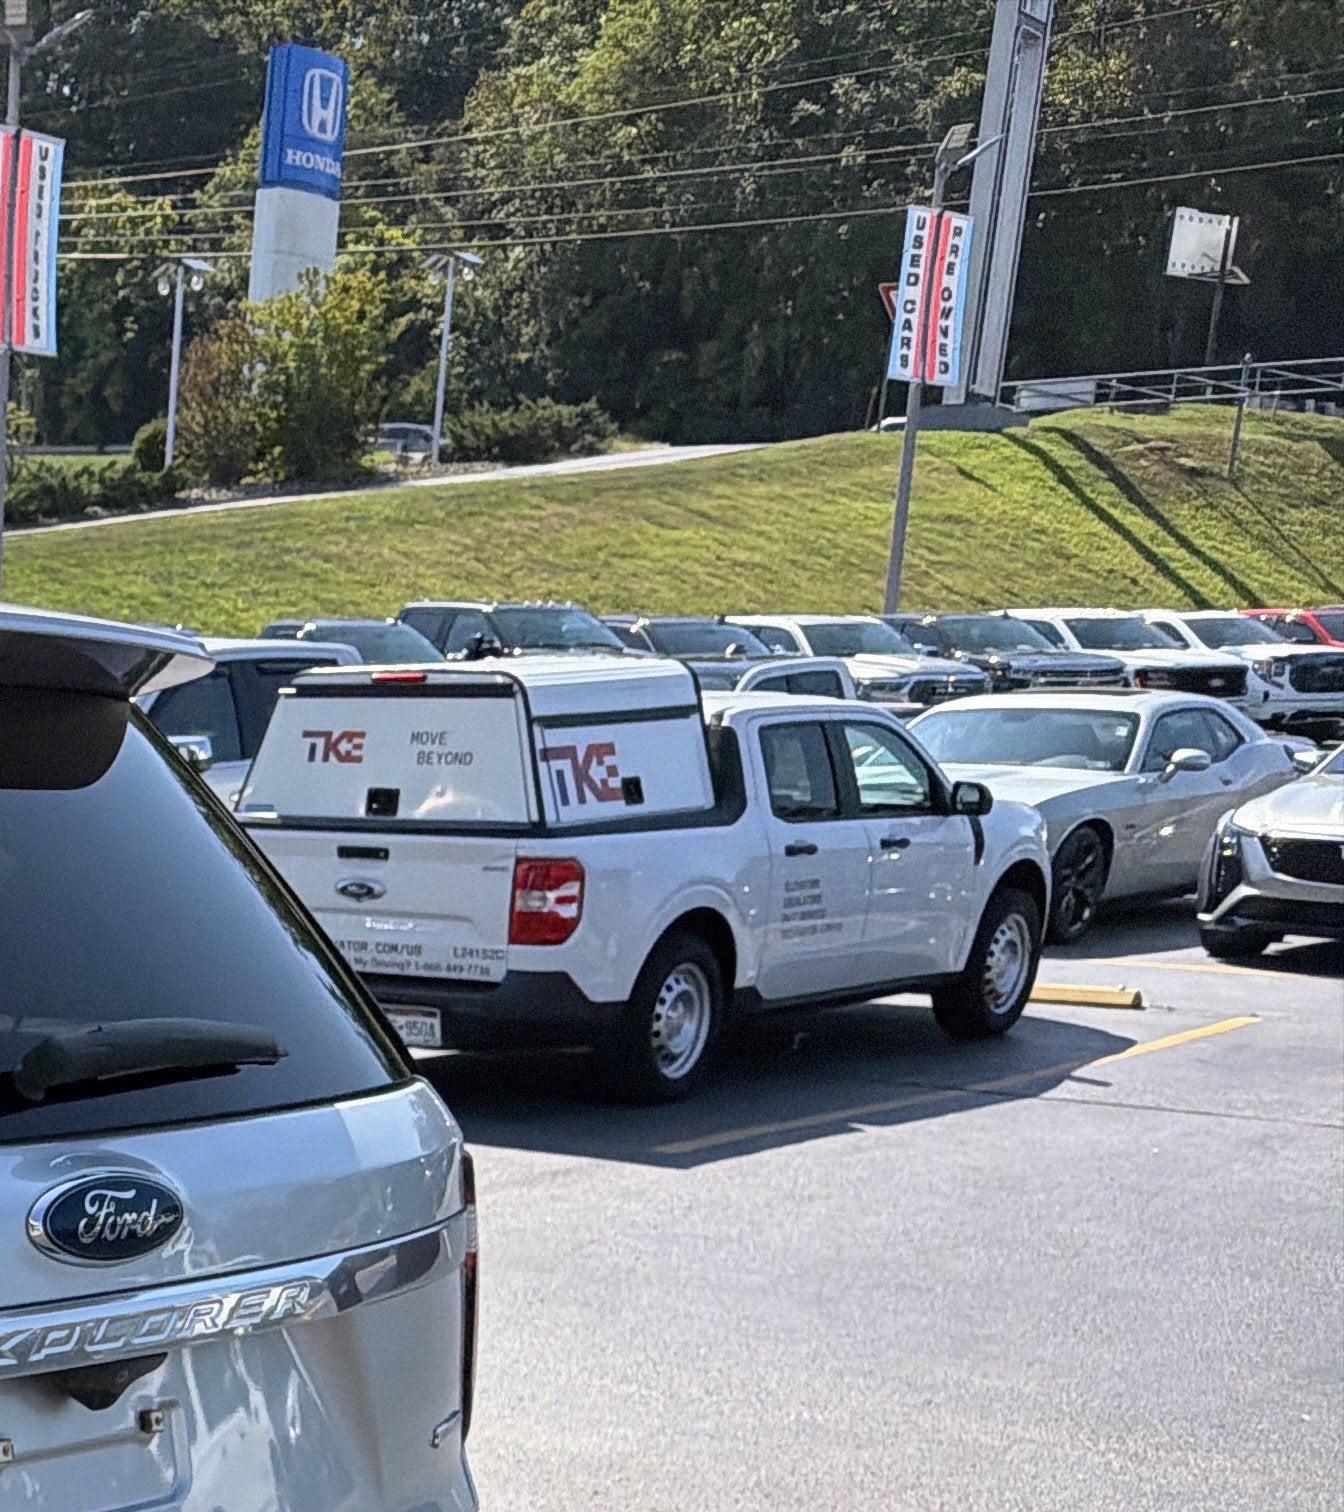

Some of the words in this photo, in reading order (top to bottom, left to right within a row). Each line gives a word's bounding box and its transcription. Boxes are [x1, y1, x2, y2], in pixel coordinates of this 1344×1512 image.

[907, 215, 926, 286] USED
[946, 226, 962, 276] PRE
[900, 300, 916, 368] CARS
[939, 287, 952, 374] OWNED
[302, 730, 366, 763] TKE
[410, 730, 448, 746] MOVE
[415, 750, 474, 766] BEYOND
[539, 742, 626, 807] TKE
[78, 1189, 179, 1244] Ford
